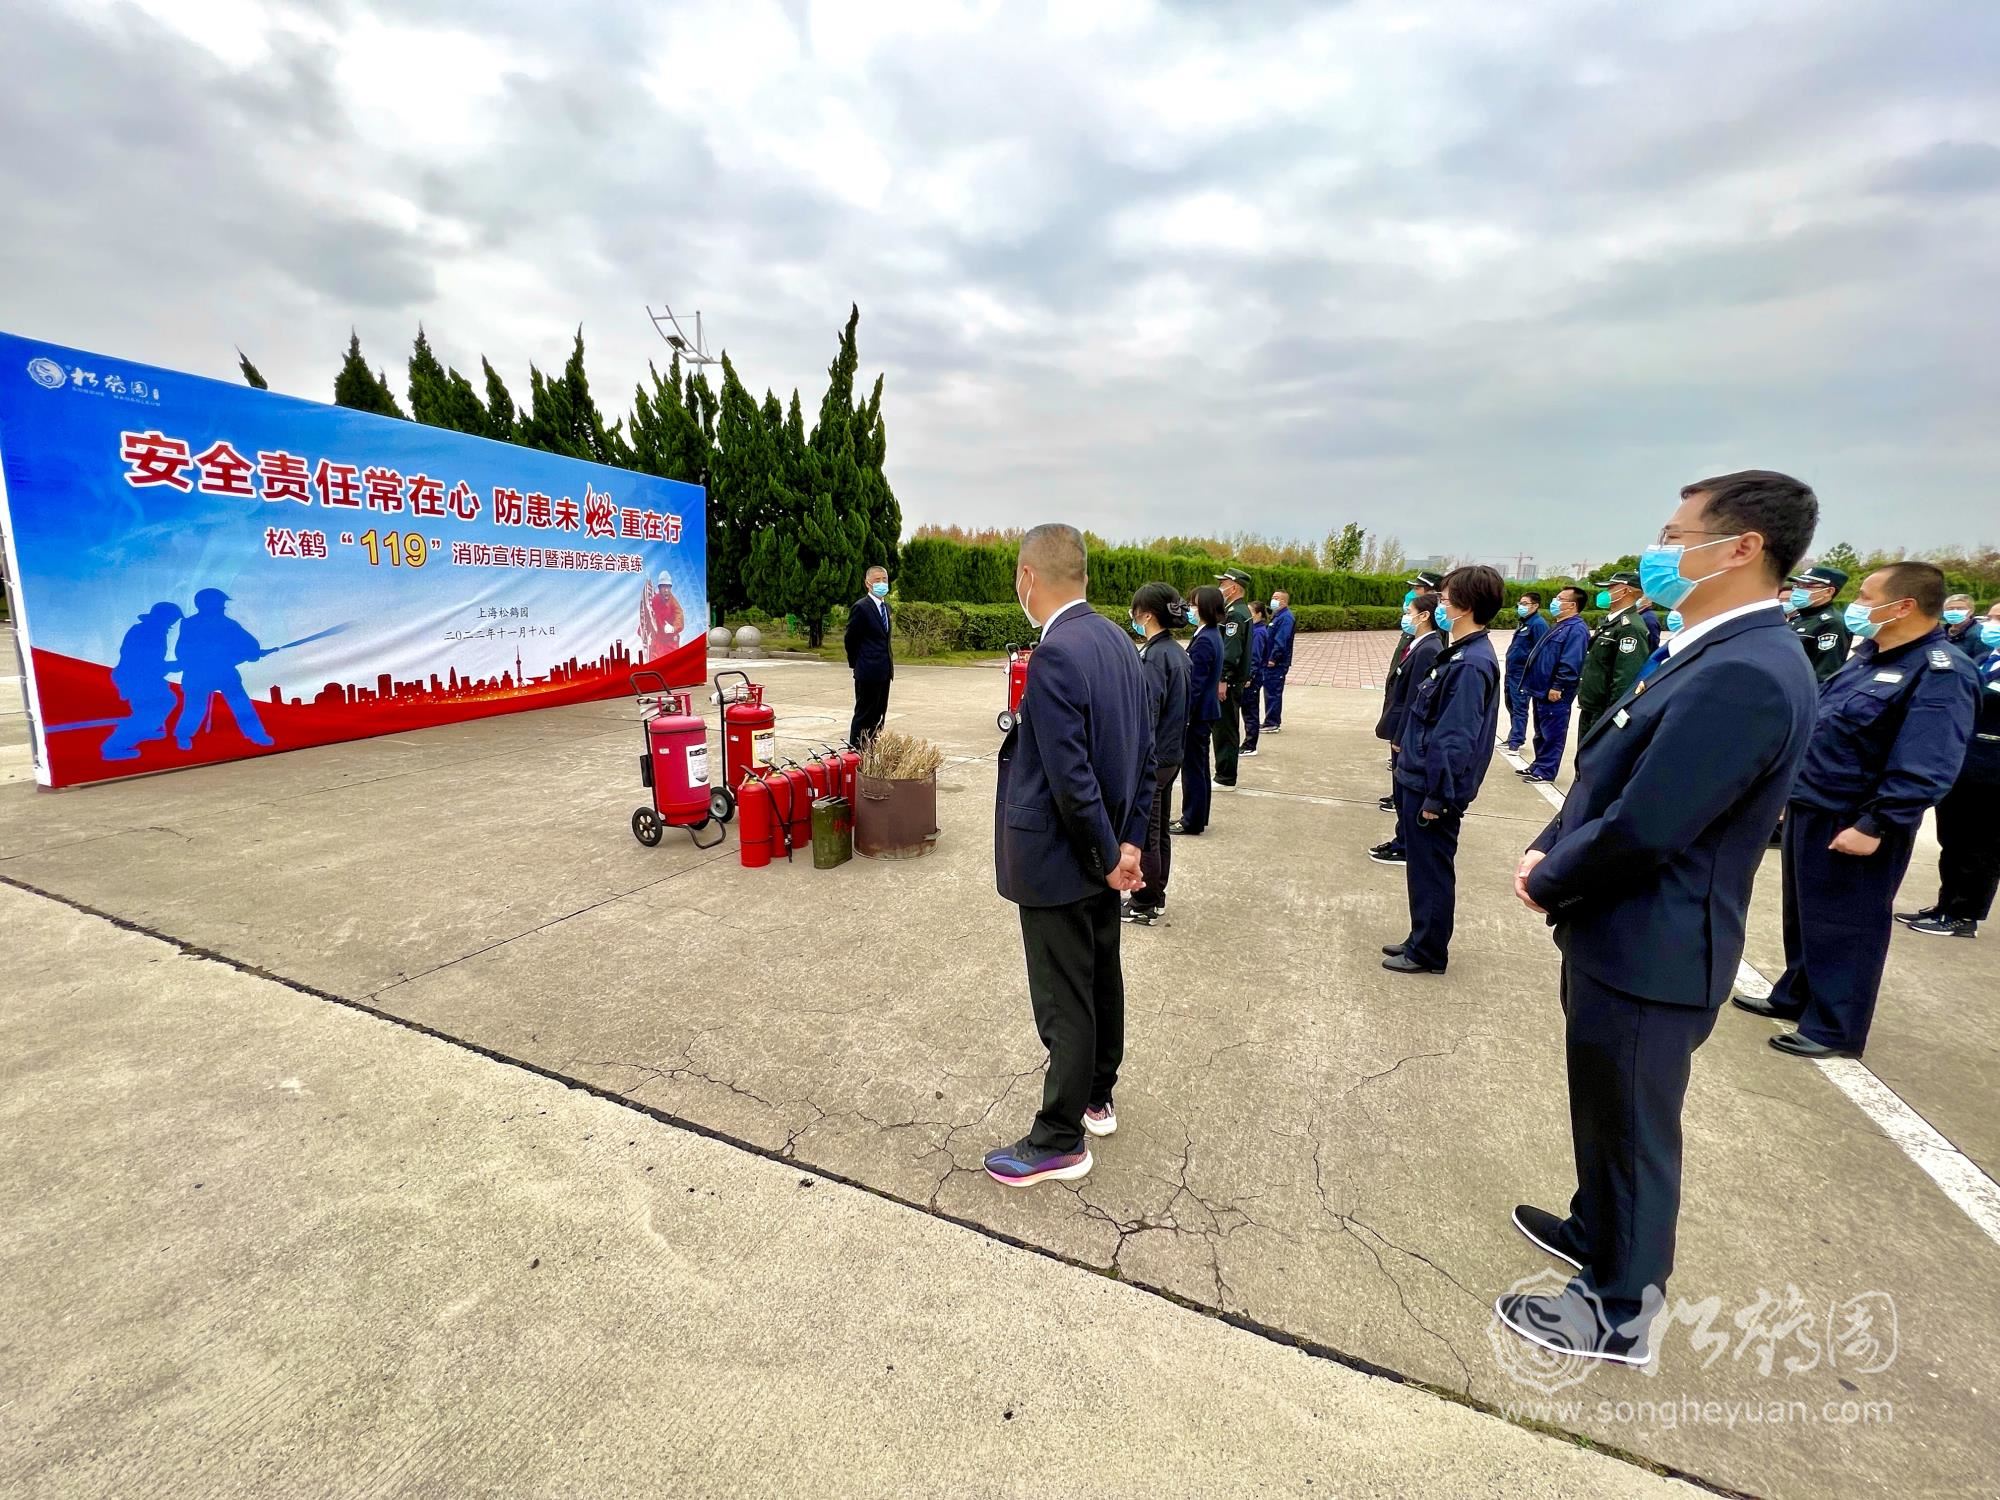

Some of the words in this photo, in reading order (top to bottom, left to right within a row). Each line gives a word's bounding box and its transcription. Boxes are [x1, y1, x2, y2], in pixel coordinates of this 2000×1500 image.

[121, 432, 483, 521] 安全责任常在心
[493, 481, 683, 543] 防患未燃重在行
[266, 528, 327, 558] 松鹤
[452, 542, 643, 573] 消防宣传月暨消防综合演练
[477, 606, 529, 619] 上海松鹤园
